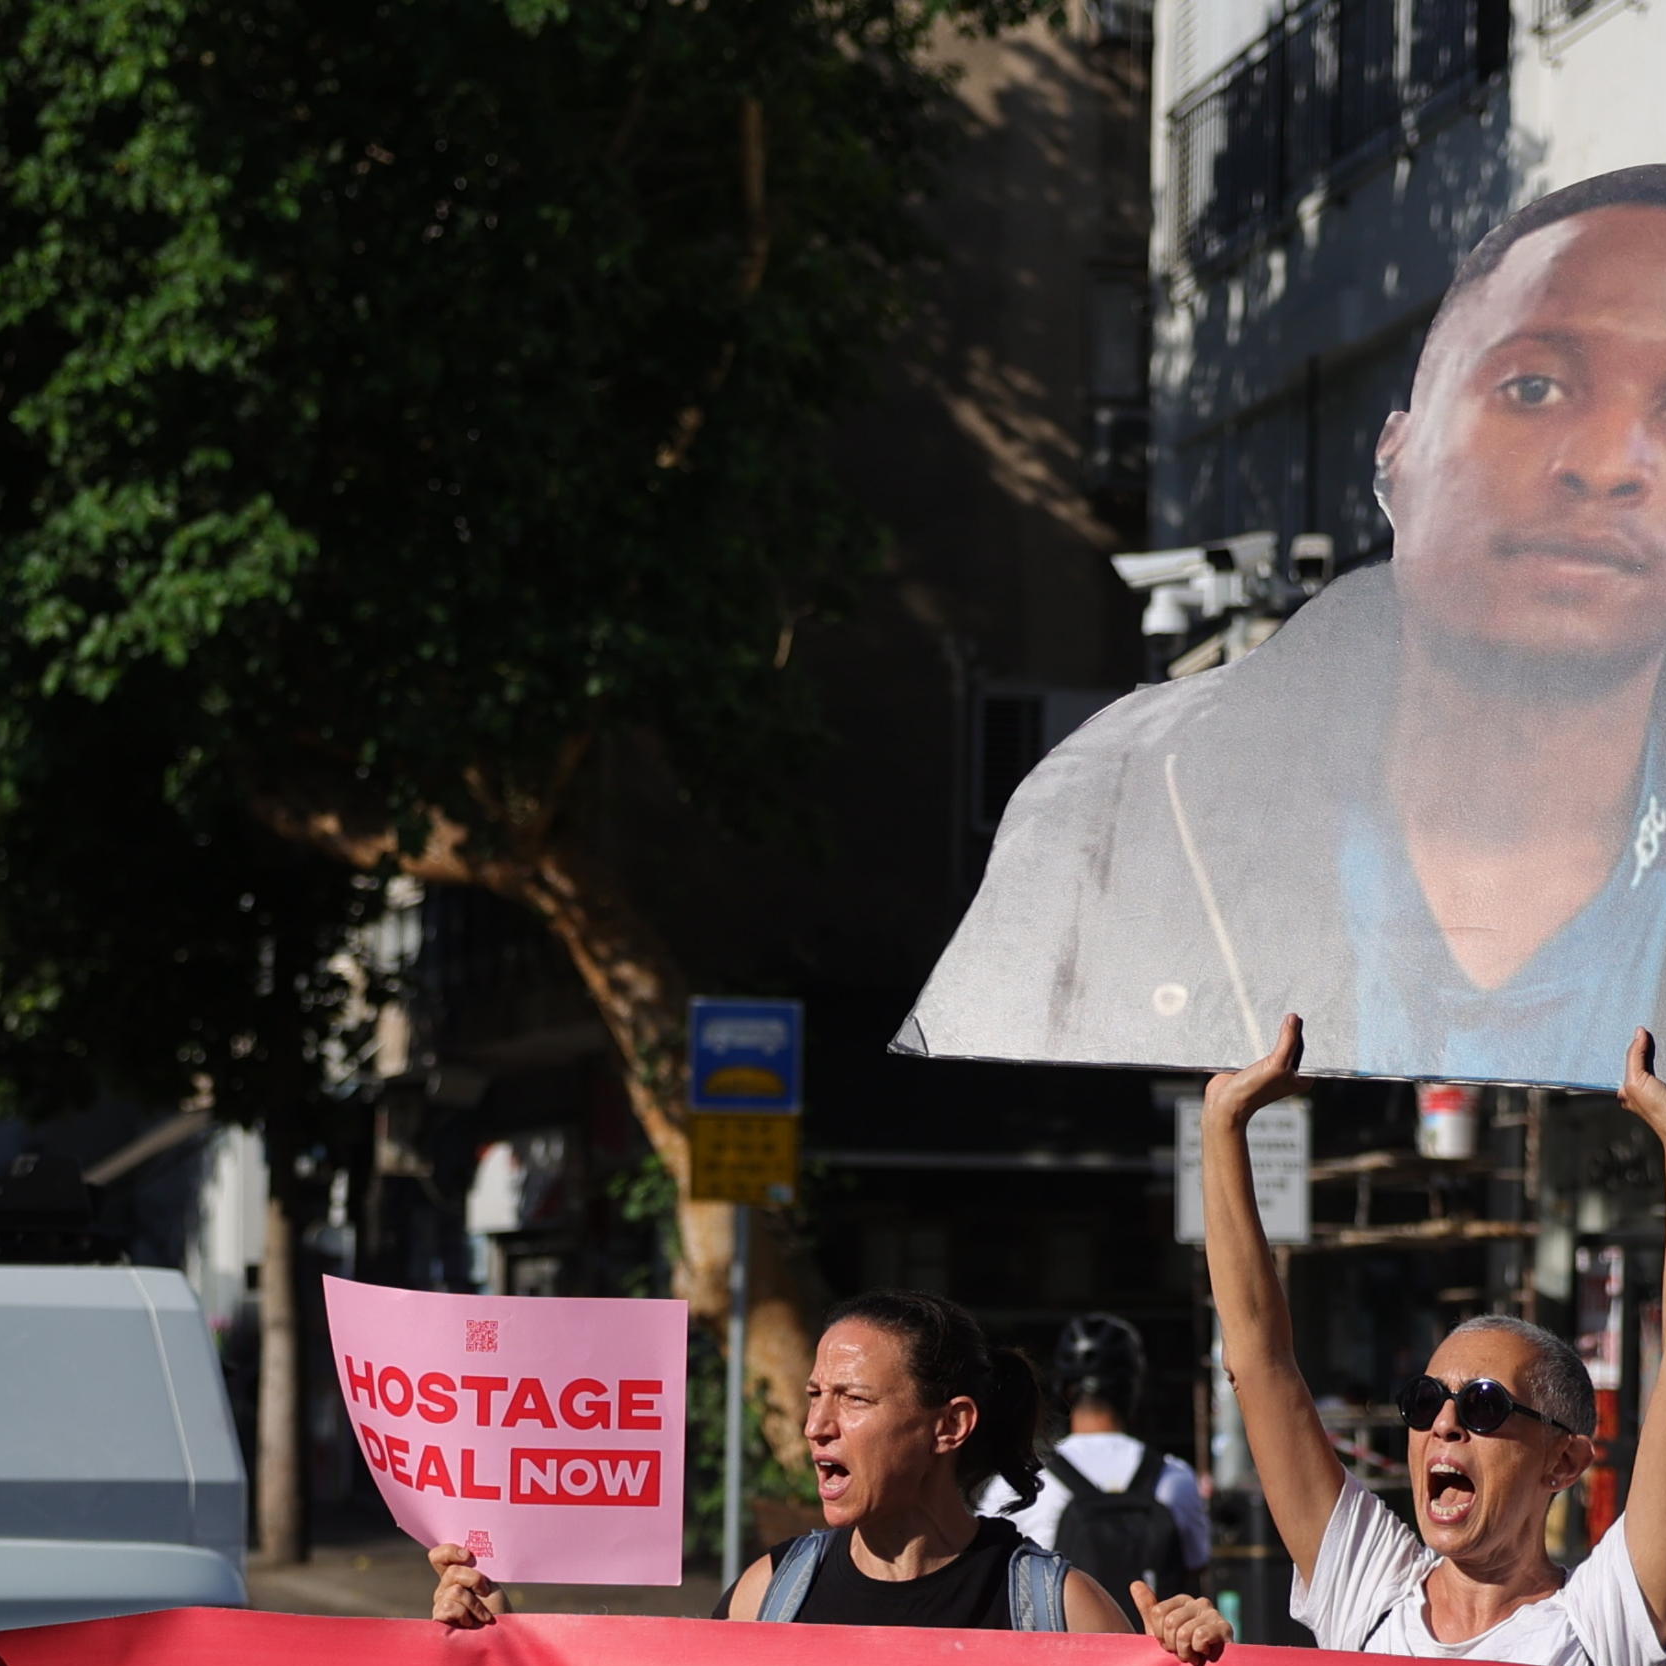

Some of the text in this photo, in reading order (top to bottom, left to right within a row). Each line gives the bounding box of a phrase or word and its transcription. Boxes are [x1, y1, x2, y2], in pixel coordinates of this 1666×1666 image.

[343, 1354, 663, 1431] HOSTAGE
[359, 1423, 650, 1500] DEAL NOW
